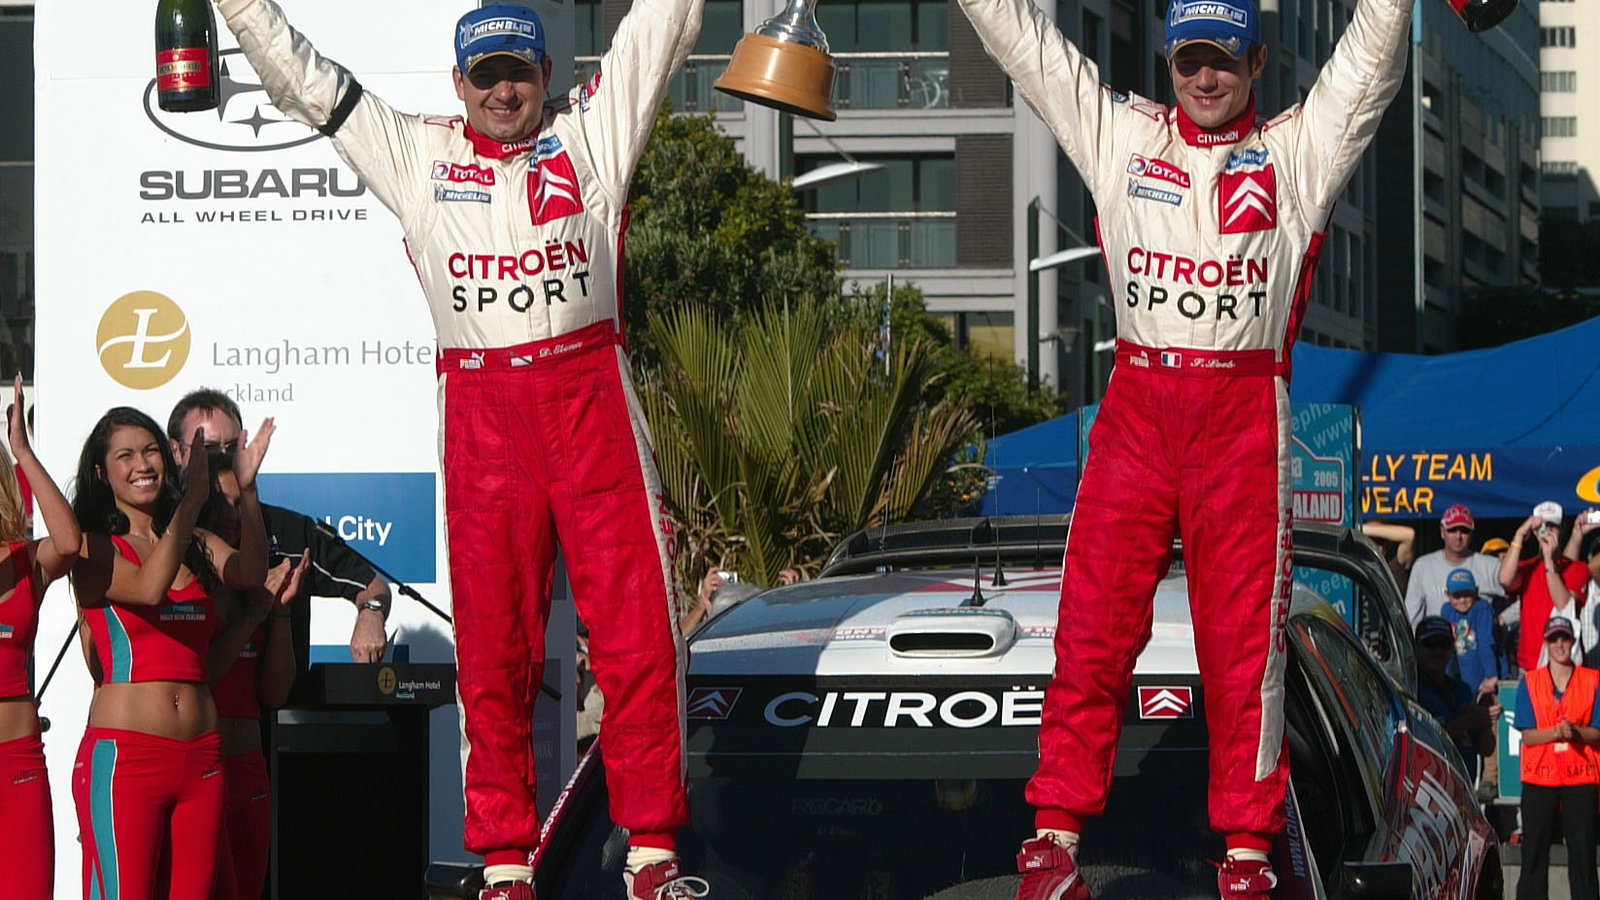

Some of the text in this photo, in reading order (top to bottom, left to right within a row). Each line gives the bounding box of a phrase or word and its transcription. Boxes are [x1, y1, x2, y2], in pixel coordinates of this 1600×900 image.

[139, 168, 367, 201] SUBARU
[452, 167, 494, 184] TOTAL
[1147, 162, 1189, 188] TOTAL
[141, 208, 368, 224] ALL WHEEL DRIVE
[448, 238, 588, 281] CITROËN
[1127, 247, 1268, 288] CITROËN
[452, 271, 590, 313] SPORT
[1126, 280, 1267, 320] SPORT
[212, 338, 438, 375] Langham Hote
[1313, 470, 1339, 488] 2005
[1412, 453, 1492, 481] TEAM
[1292, 492, 1341, 520] ALAND
[338, 515, 392, 546] City
[763, 684, 1045, 728] CITROË
